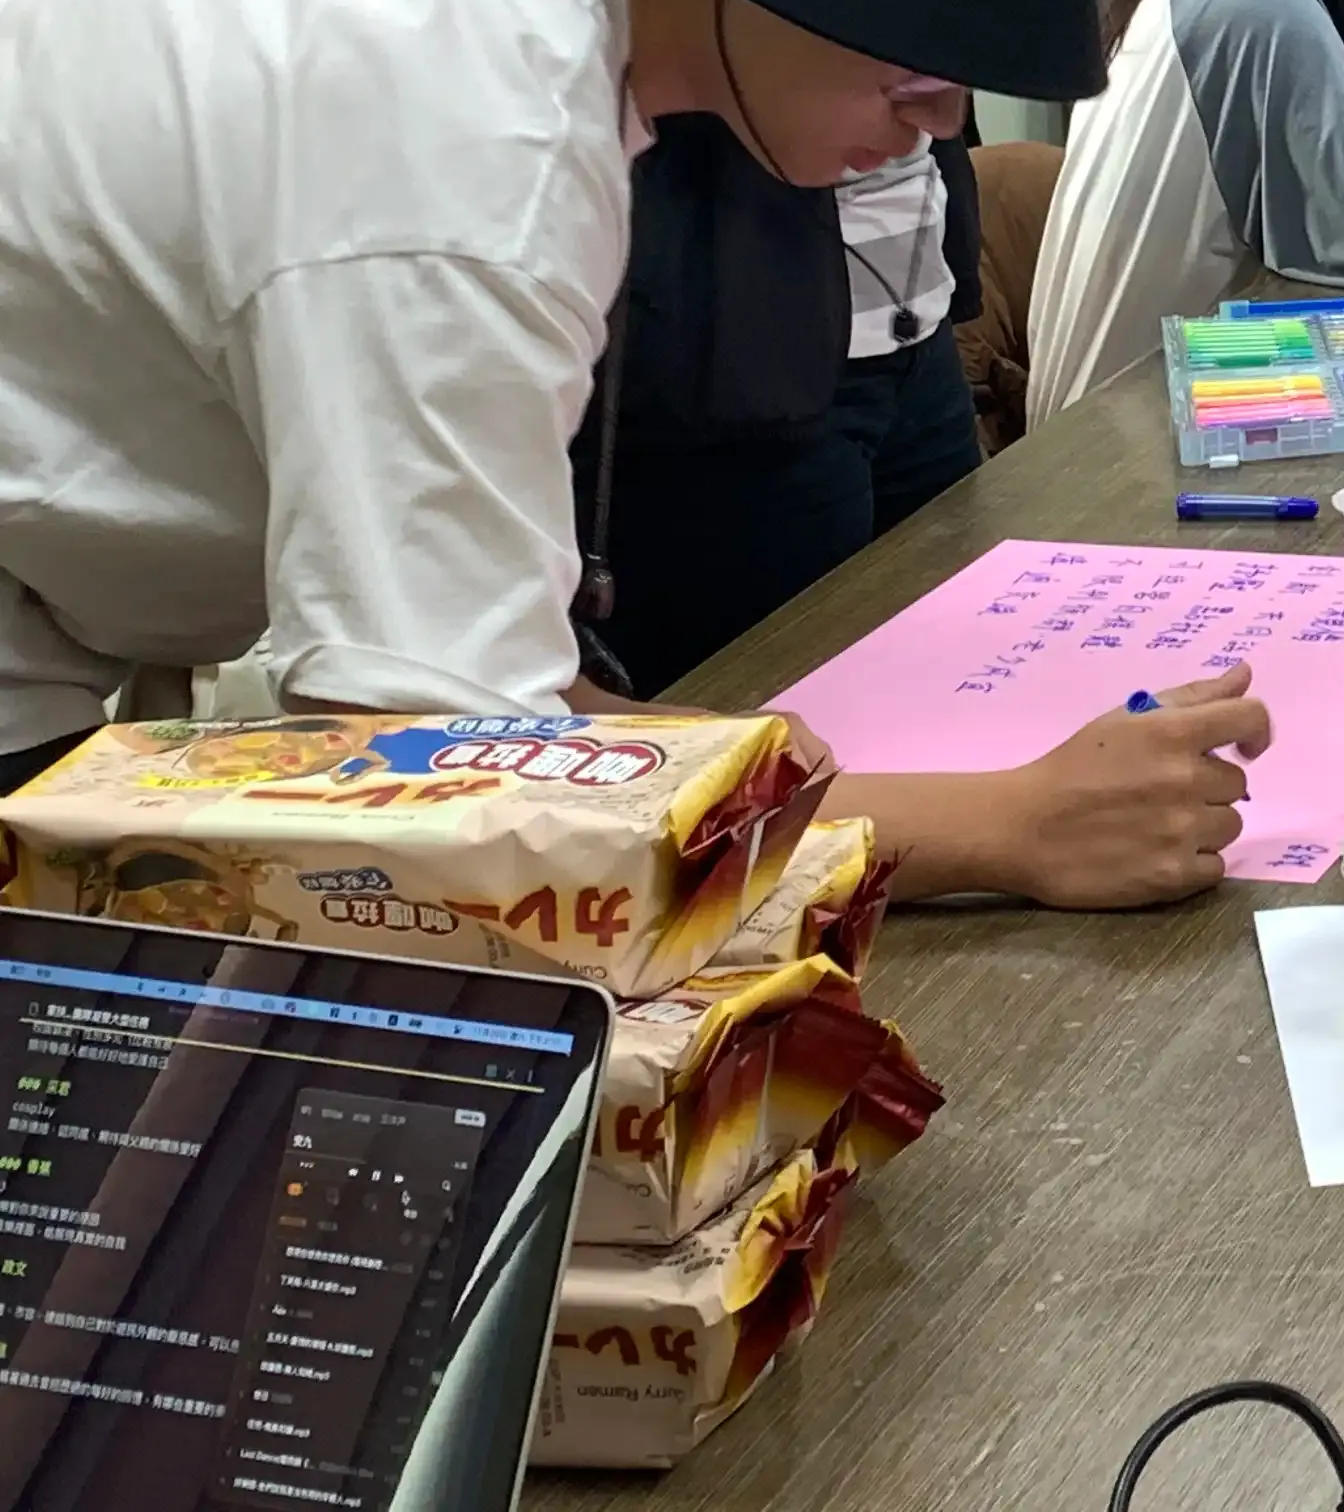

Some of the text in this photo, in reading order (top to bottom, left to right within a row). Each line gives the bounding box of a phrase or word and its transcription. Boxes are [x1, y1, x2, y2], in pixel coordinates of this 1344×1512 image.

[443, 886, 632, 947] カレー
[577, 1386, 638, 1404] Ramen
